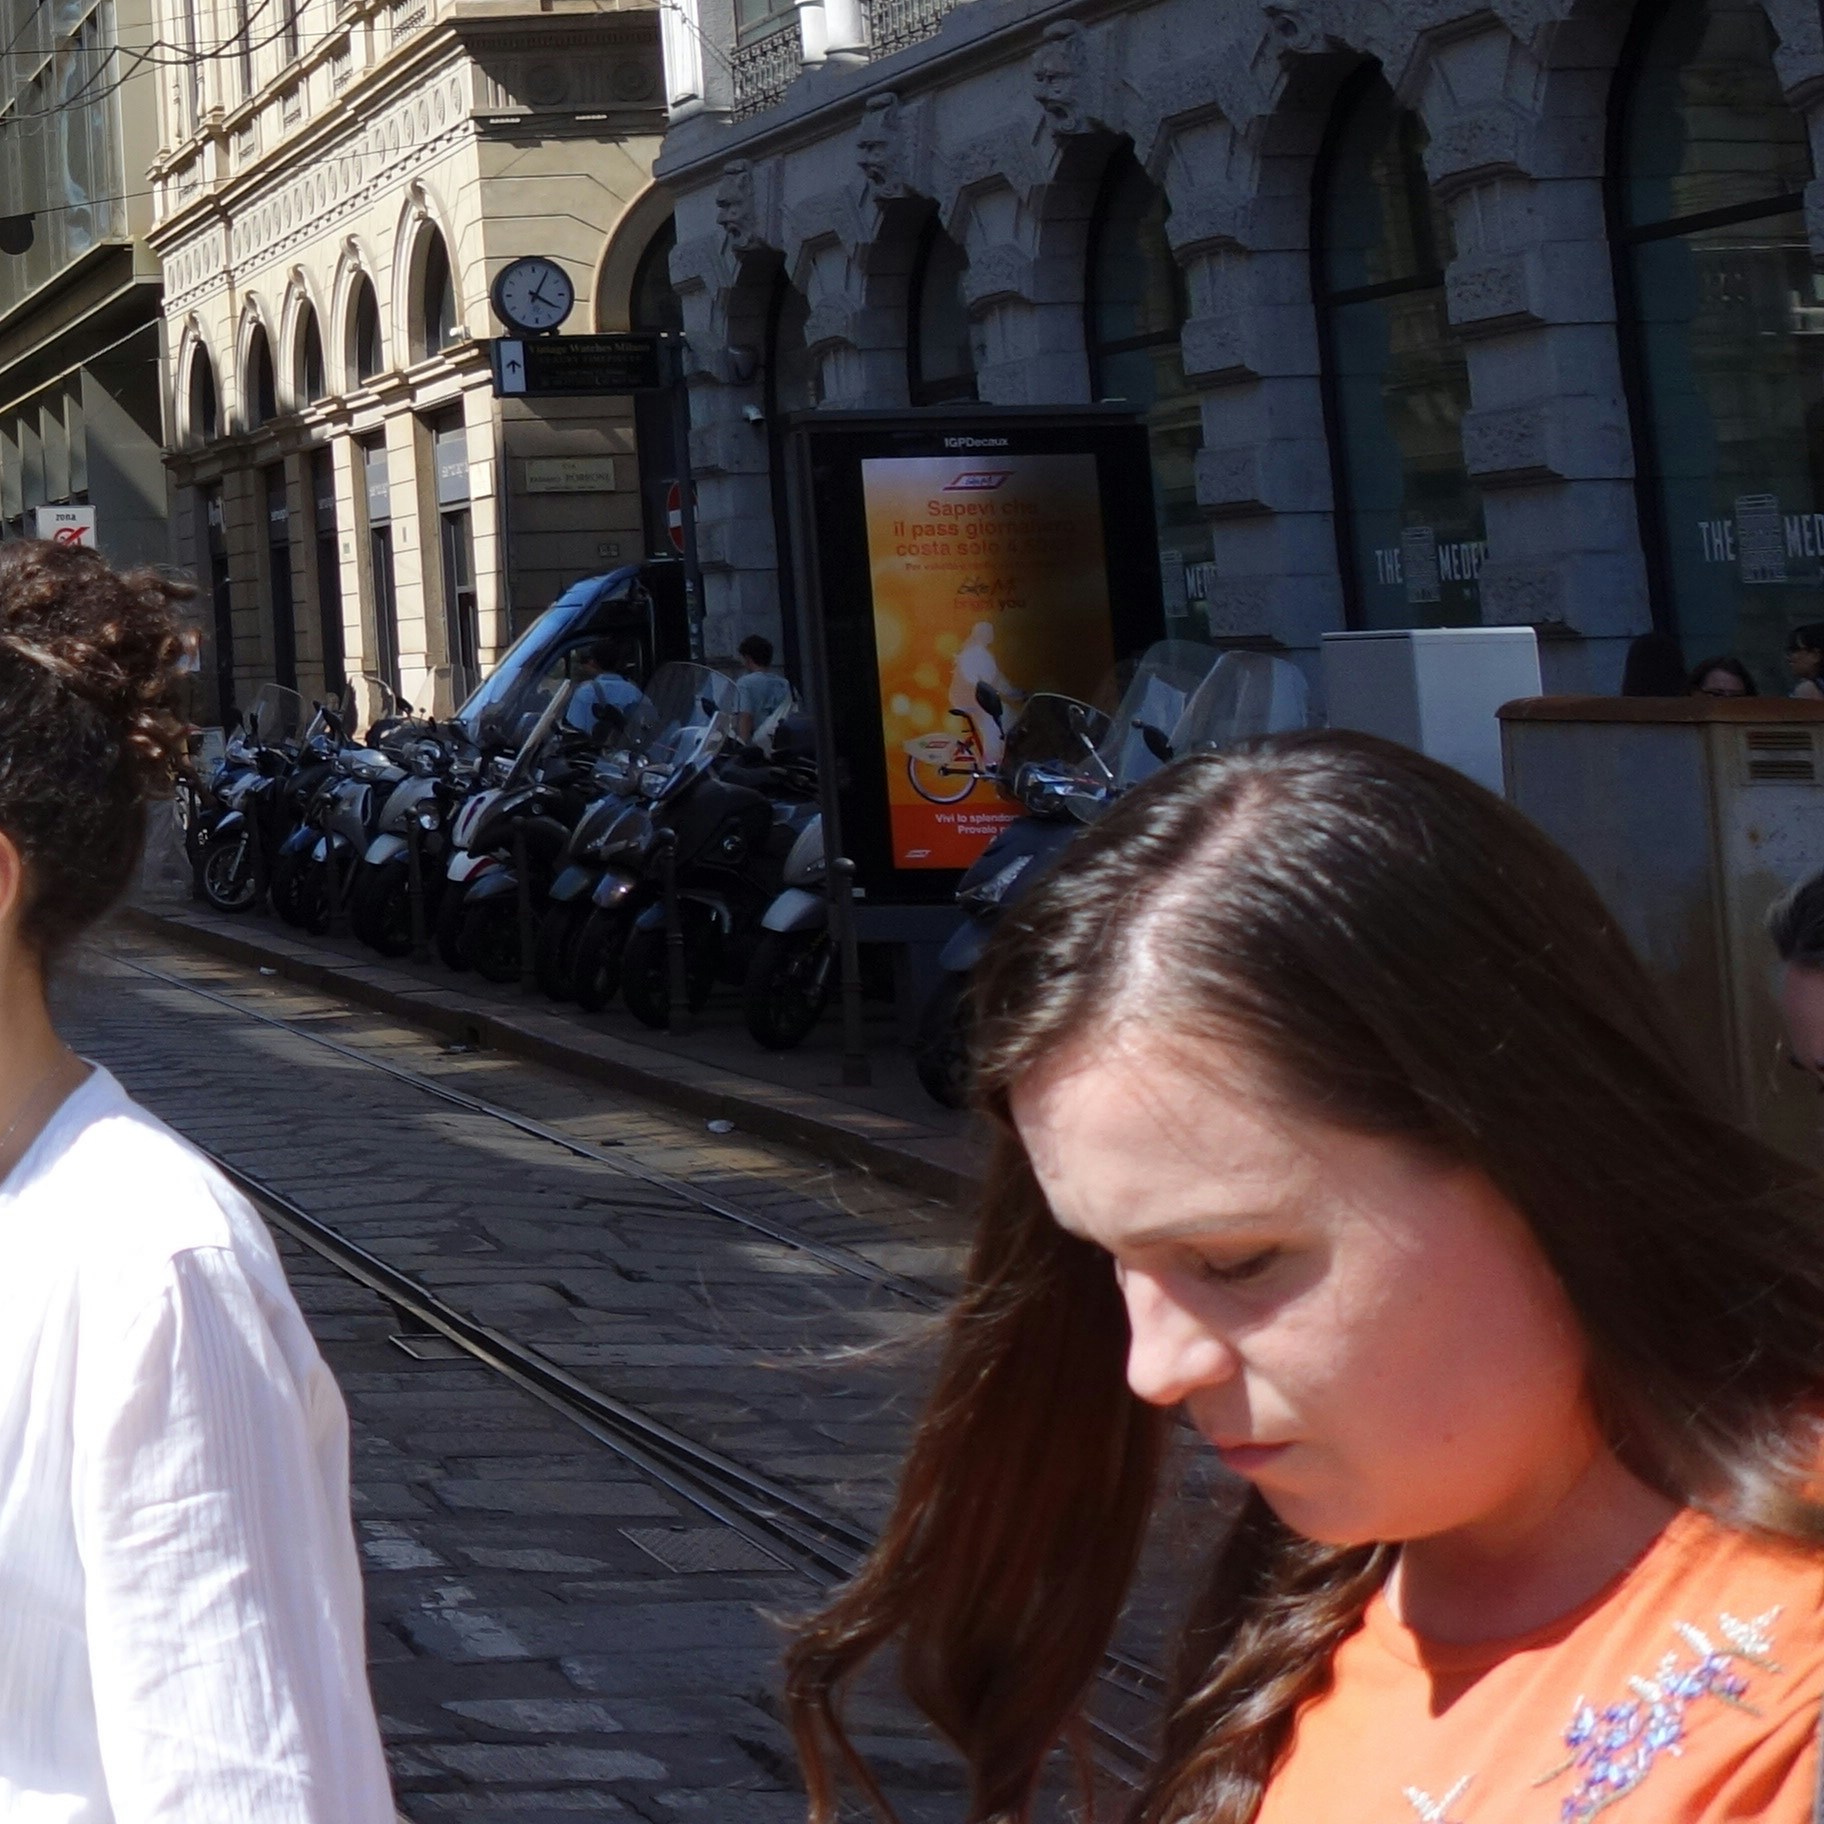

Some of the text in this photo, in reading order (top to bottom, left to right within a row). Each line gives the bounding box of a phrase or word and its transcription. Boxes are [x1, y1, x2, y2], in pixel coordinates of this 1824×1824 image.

[944, 437, 1009, 448] IGPDecaux
[56, 513, 76, 522] zona
[928, 499, 1036, 520] Sapevi che
[894, 521, 905, 537] il
[912, 523, 959, 541] pass
[896, 540, 952, 557] costa
[957, 539, 1001, 556] solo
[1697, 519, 1736, 562] THE
[1375, 548, 1403, 585] THE
[999, 598, 1026, 612] you
[935, 813, 955, 824] Vivi
[956, 813, 968, 823] lo
[958, 825, 998, 835] Provalo
